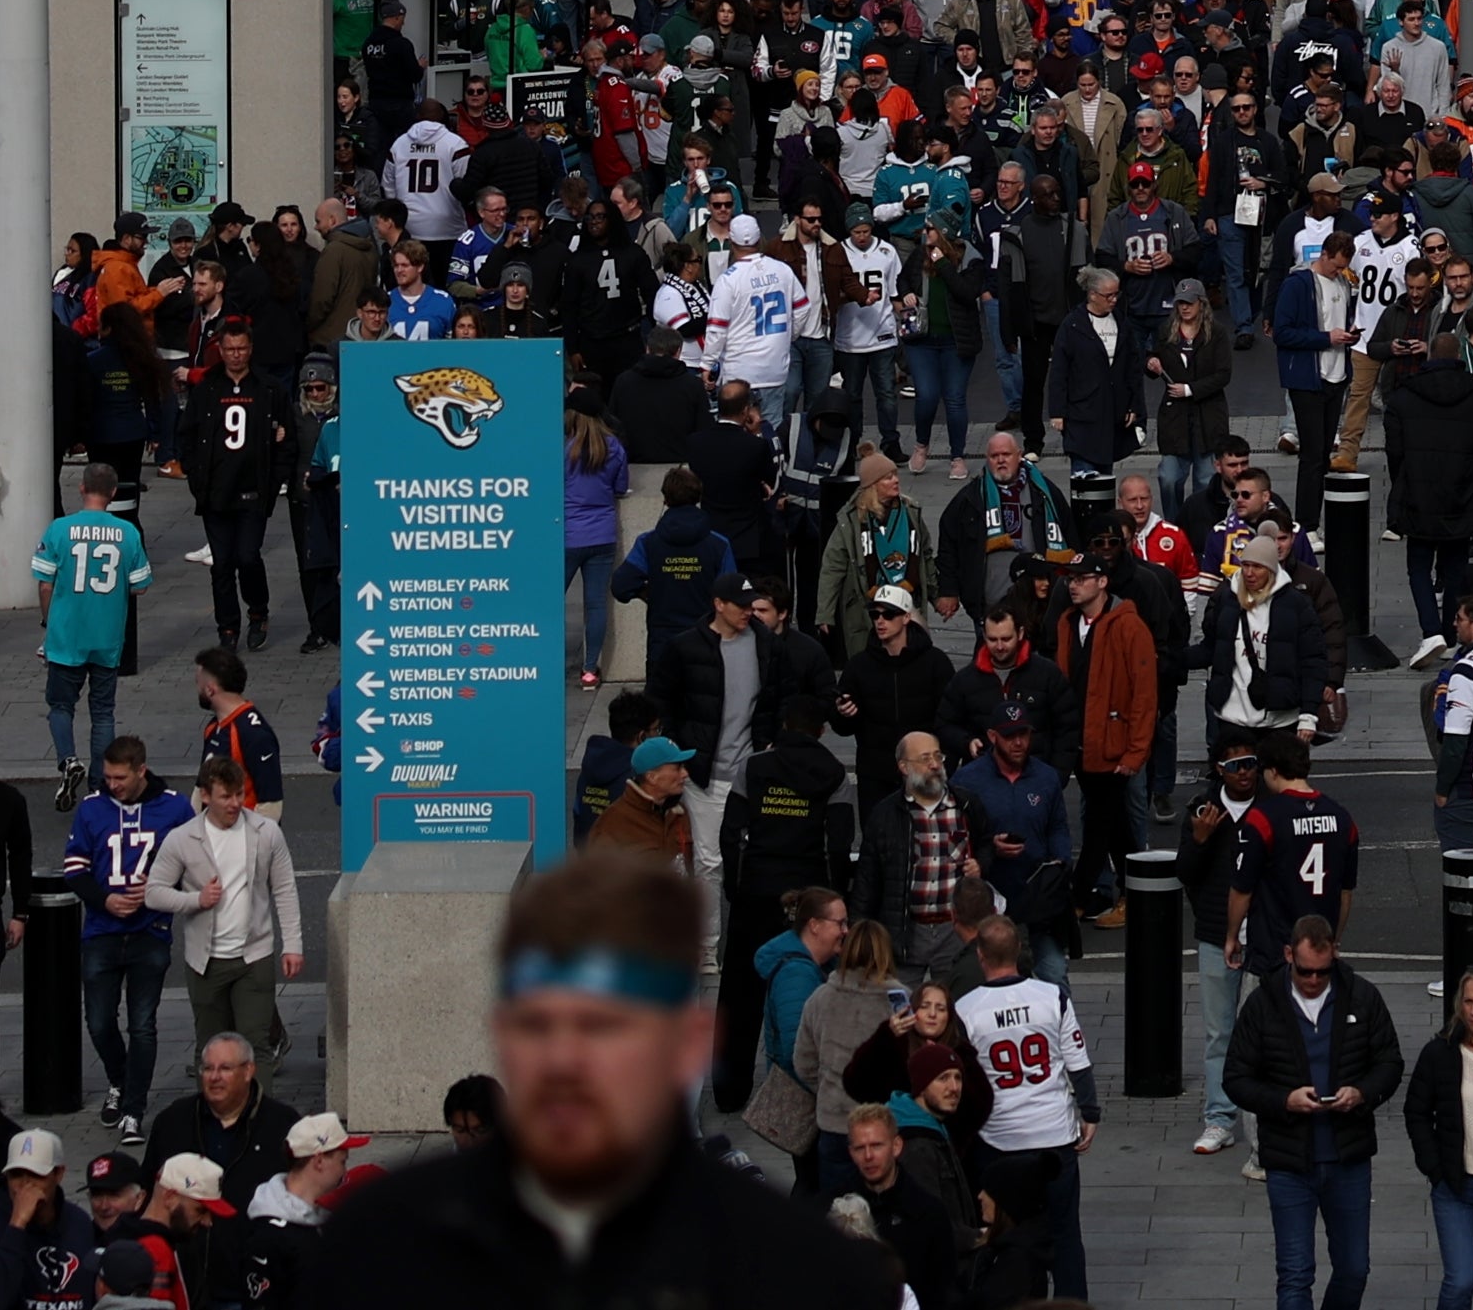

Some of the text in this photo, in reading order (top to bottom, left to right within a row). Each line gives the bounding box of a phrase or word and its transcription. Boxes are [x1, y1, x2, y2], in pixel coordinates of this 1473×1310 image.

[409, 143, 437, 153] SMITH
[406, 159, 440, 194] 10
[596, 258, 622, 299] 4
[750, 274, 780, 290] COLLINS
[1361, 264, 1397, 306] 86
[750, 290, 787, 337] 12
[223, 404, 248, 450] 9
[374, 478, 529, 499] THANKS FOR
[400, 504, 504, 525] VISITING
[70, 525, 124, 544] MARINO
[391, 530, 514, 551] WEMBLEY
[72, 542, 122, 594] 13
[389, 579, 509, 592] WEMBLEY PARK
[389, 597, 453, 611] STATION
[389, 624, 540, 639] WEMBLEY CENTRAL
[389, 644, 453, 657] STATION
[389, 667, 537, 682] WEMBLEY STADIUM
[389, 687, 453, 700] STATION
[389, 713, 433, 726] TAXIS
[414, 741, 444, 751] SHOP
[390, 764, 458, 782] DUUUVAL!
[414, 802, 493, 817] WARNING
[762, 795, 810, 808] ENGAGEMENT
[761, 806, 811, 818] MANAGEMENT
[437, 826, 454, 834] MAY
[455, 826, 465, 834] BE
[465, 825, 488, 834] FINED
[1292, 815, 1339, 836] WATSON
[106, 832, 156, 887] 17
[1298, 841, 1327, 895] 4
[994, 1006, 1031, 1028] WATT
[988, 1033, 1051, 1089] 99
